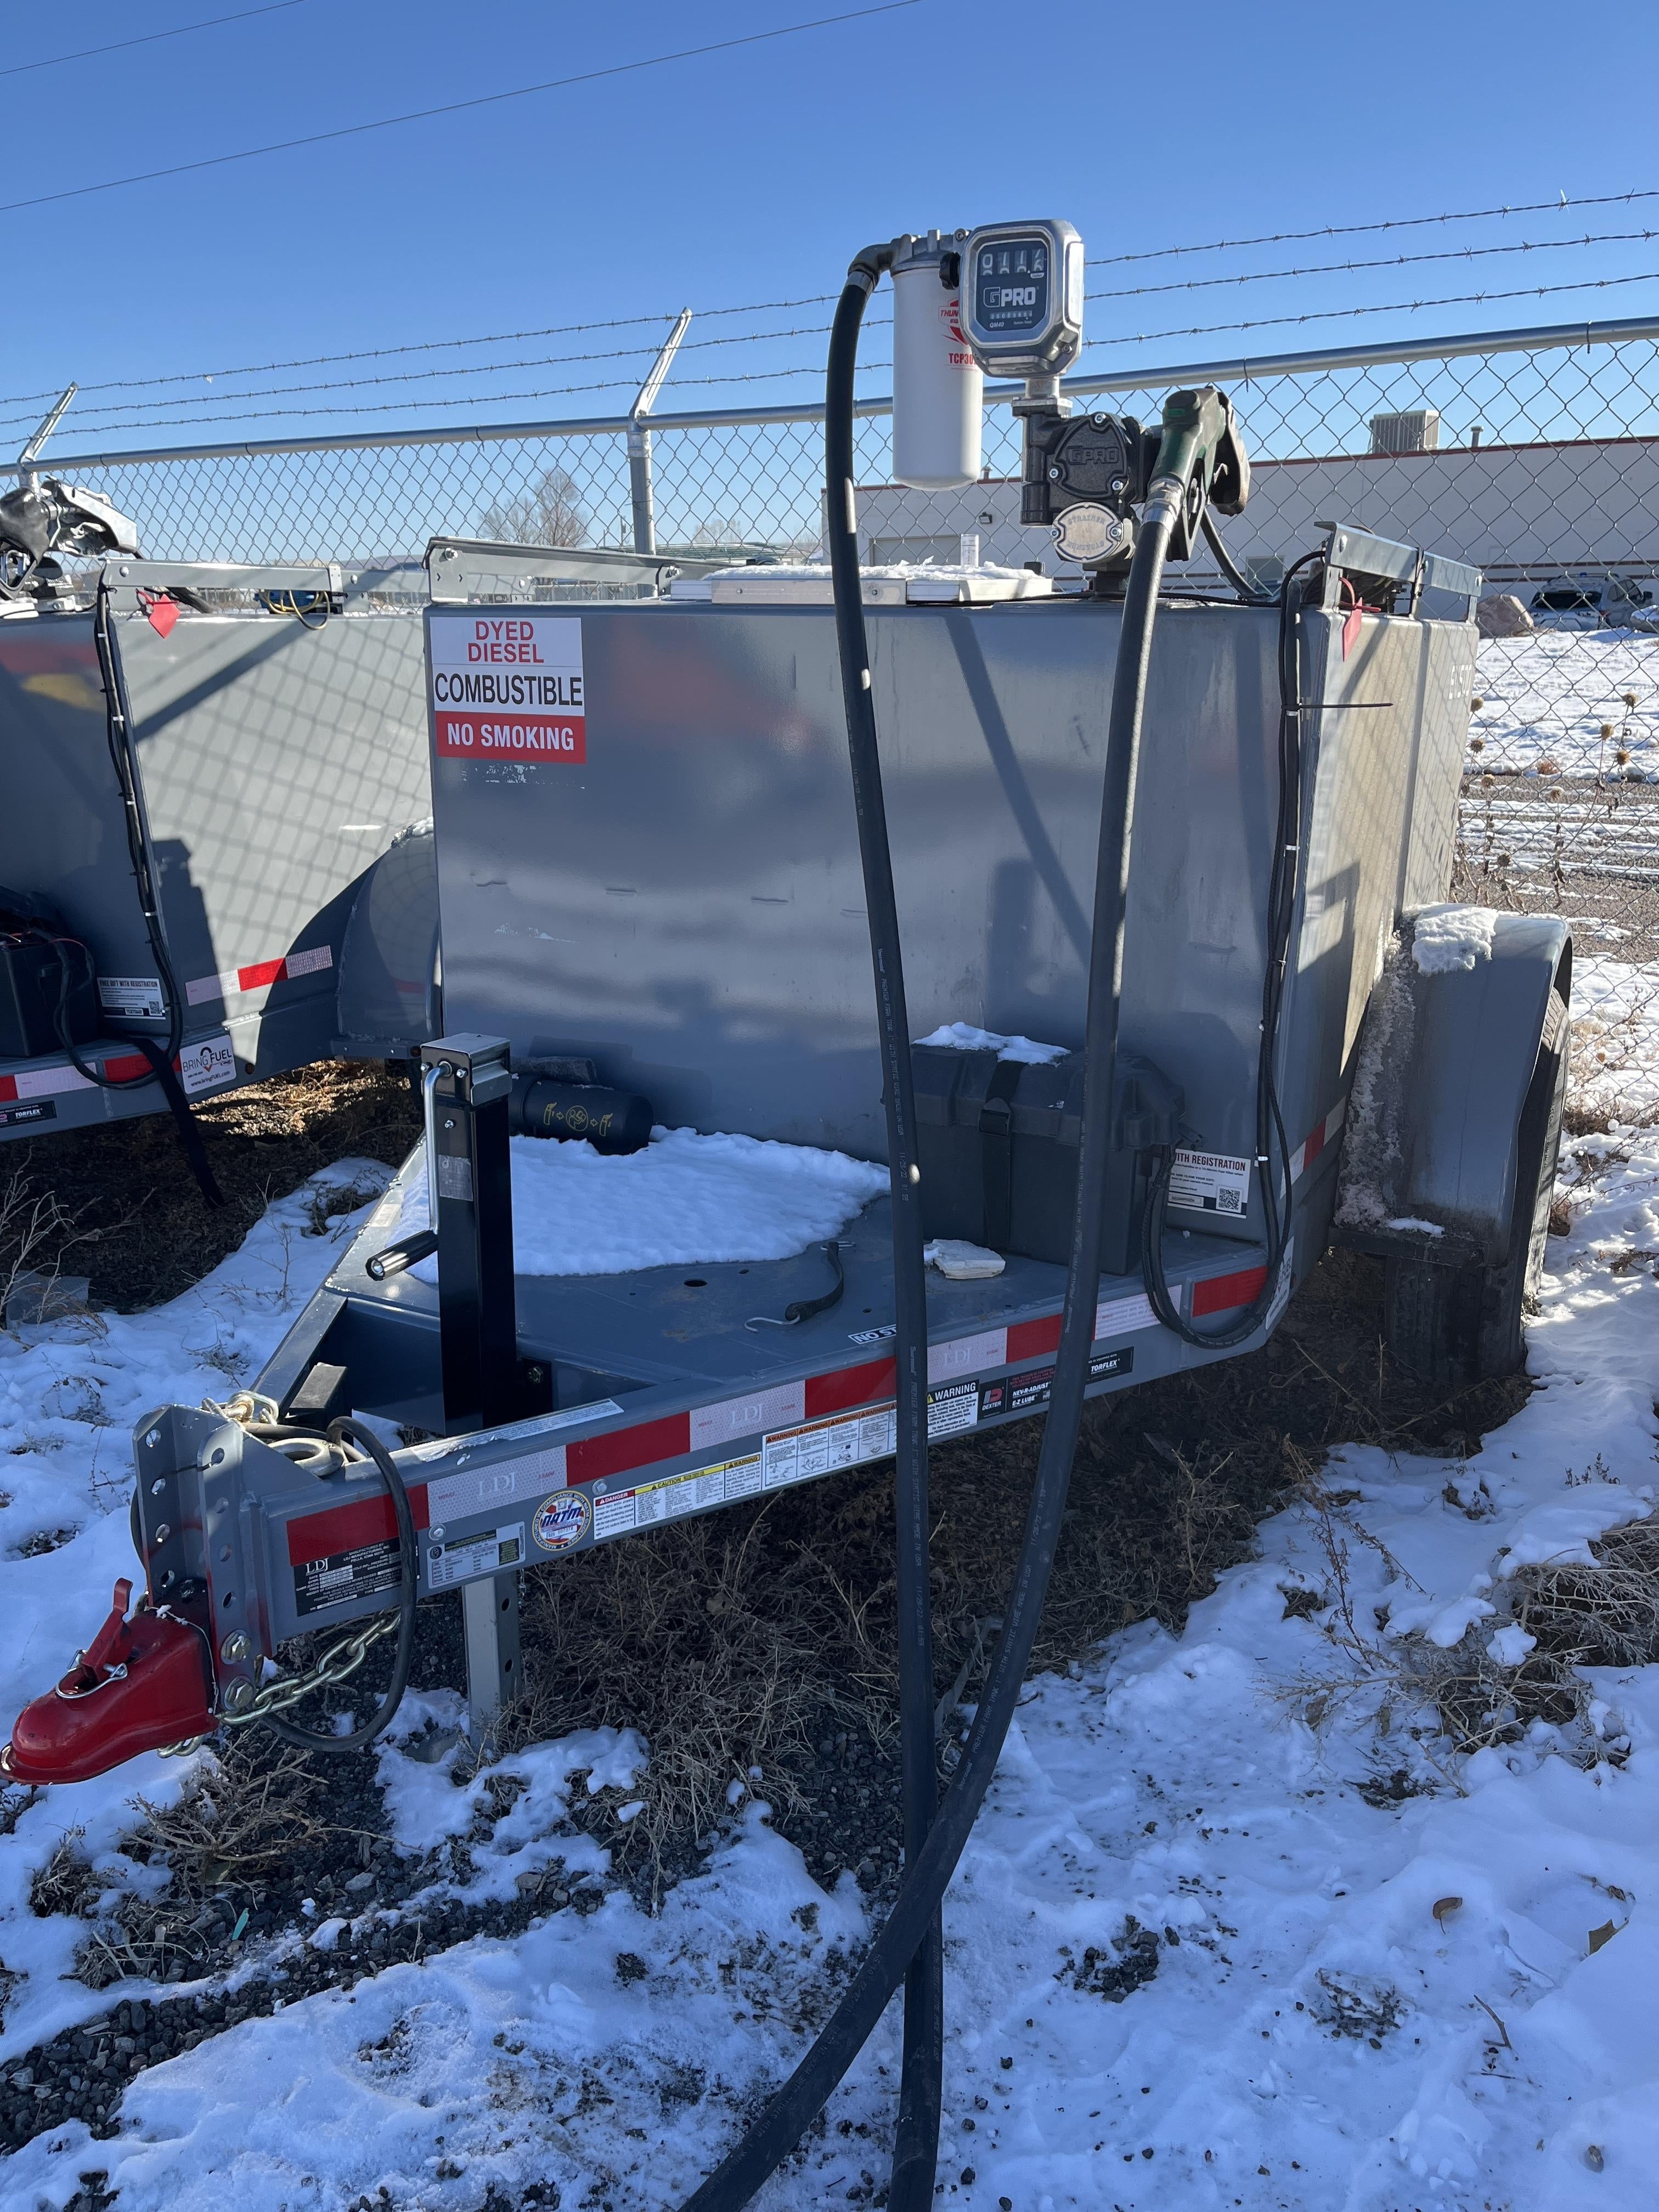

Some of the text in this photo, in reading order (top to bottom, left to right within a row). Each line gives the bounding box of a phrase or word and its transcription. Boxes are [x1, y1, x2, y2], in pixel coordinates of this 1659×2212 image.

[984, 287, 1036, 308] GPRO
[949, 353, 977, 365] TCP30
[1066, 445, 1119, 465] GPRO
[475, 621, 534, 640] DYED
[468, 643, 544, 663] DIESEL
[435, 673, 583, 706] COMBUSTIBLE
[447, 723, 574, 751] NO SMOKING
[183, 1056, 208, 1073] BRING
[210, 1048, 232, 1063] FUEL
[15, 1109, 41, 1118] TORFLEX
[1175, 1153, 1189, 1163] ITH
[1192, 1155, 1246, 1171] REGISTRATION
[853, 1327, 896, 1342] NO ST
[1091, 1359, 1118, 1372] TORFLEX
[935, 1383, 976, 1401] WARNING
[1013, 1382, 1049, 1397] NEV-R-ADJUST
[982, 1401, 1002, 1411] DEXTER
[1022, 1395, 1035, 1404] LUBE
[730, 1403, 764, 1426] LDJ
[865, 1405, 890, 1415] WARNING
[834, 1414, 859, 1424] WARNING
[803, 1422, 828, 1433] WARNING
[771, 1431, 796, 1441] WARNING
[733, 1456, 758, 1466] WARNING
[478, 1472, 515, 1497] LDJ
[658, 1477, 681, 1487] CAUTION
[541, 1493, 573, 1511] COMPLIANCE
[605, 1492, 628, 1503] DANGER
[541, 1506, 583, 1527] NATM
[306, 1558, 329, 1573] LDJ
[1022, 1565, 1031, 1577] USA
[1022, 1579, 1029, 1588] IN
[1017, 1592, 1026, 1608] MADE
[1012, 1610, 1021, 1627] WIRE
[1005, 1629, 1016, 1654] STATIC
[998, 1655, 1008, 1673] WITH
[990, 1686, 999, 1702] TANK
[983, 1705, 992, 1722] FARM
[972, 1724, 986, 1754] PREMIER
